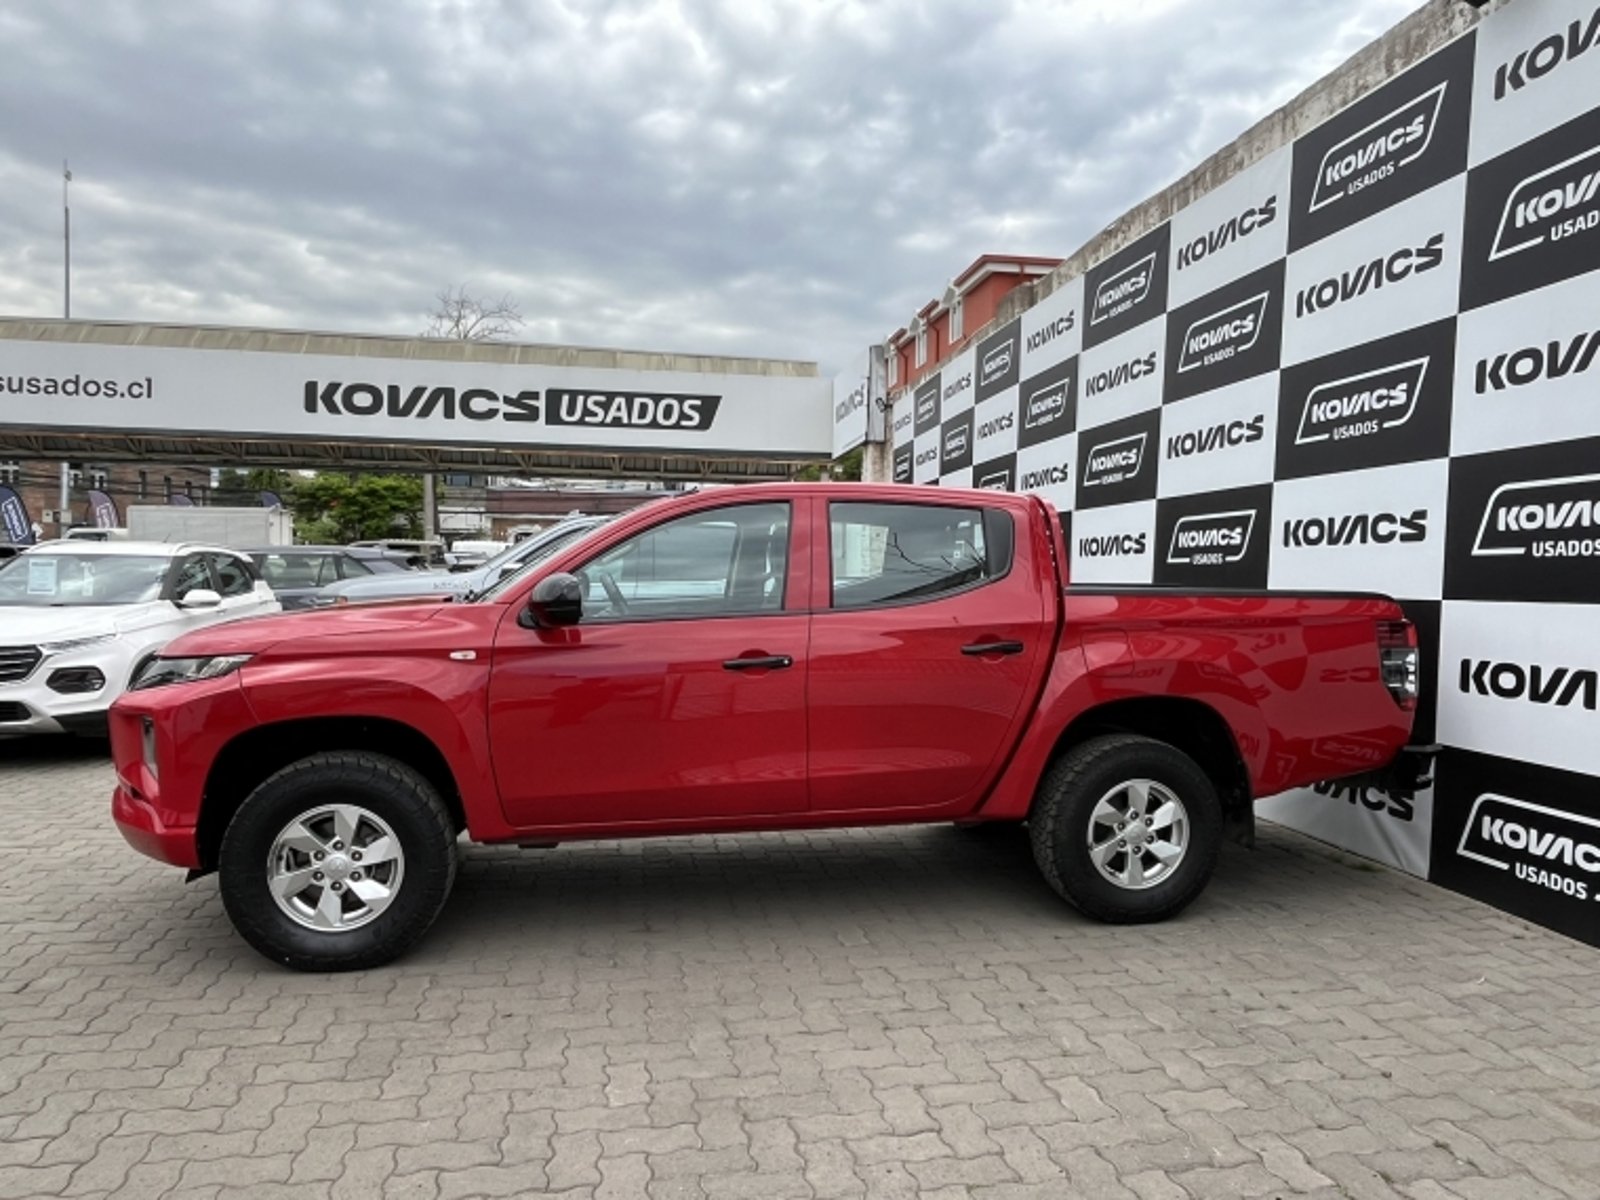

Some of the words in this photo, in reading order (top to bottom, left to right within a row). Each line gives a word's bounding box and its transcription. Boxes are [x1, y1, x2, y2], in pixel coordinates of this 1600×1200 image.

[1494, 5, 1600, 101] KOV
[1325, 114, 1424, 186] KOVACS
[1347, 161, 1395, 195] USADOS
[1177, 195, 1277, 271] KOVACS
[1296, 233, 1444, 318] KOVACS
[1189, 313, 1255, 355] KOVACS
[1086, 351, 1157, 397] KOVACS
[304, 381, 540, 422] KOVACS
[559, 395, 702, 427] USADOS
[1311, 382, 1407, 424] KOVACS
[1167, 414, 1264, 459] KOVACS
[1333, 419, 1379, 440] USADOS
[1092, 448, 1138, 472] KOVACS
[1079, 532, 1146, 558] KOVACS
[1178, 526, 1243, 549] KOVACS
[1283, 509, 1428, 548] KOVACS
[1459, 658, 1598, 711] KOVA
[1515, 862, 1588, 900] USADOS
